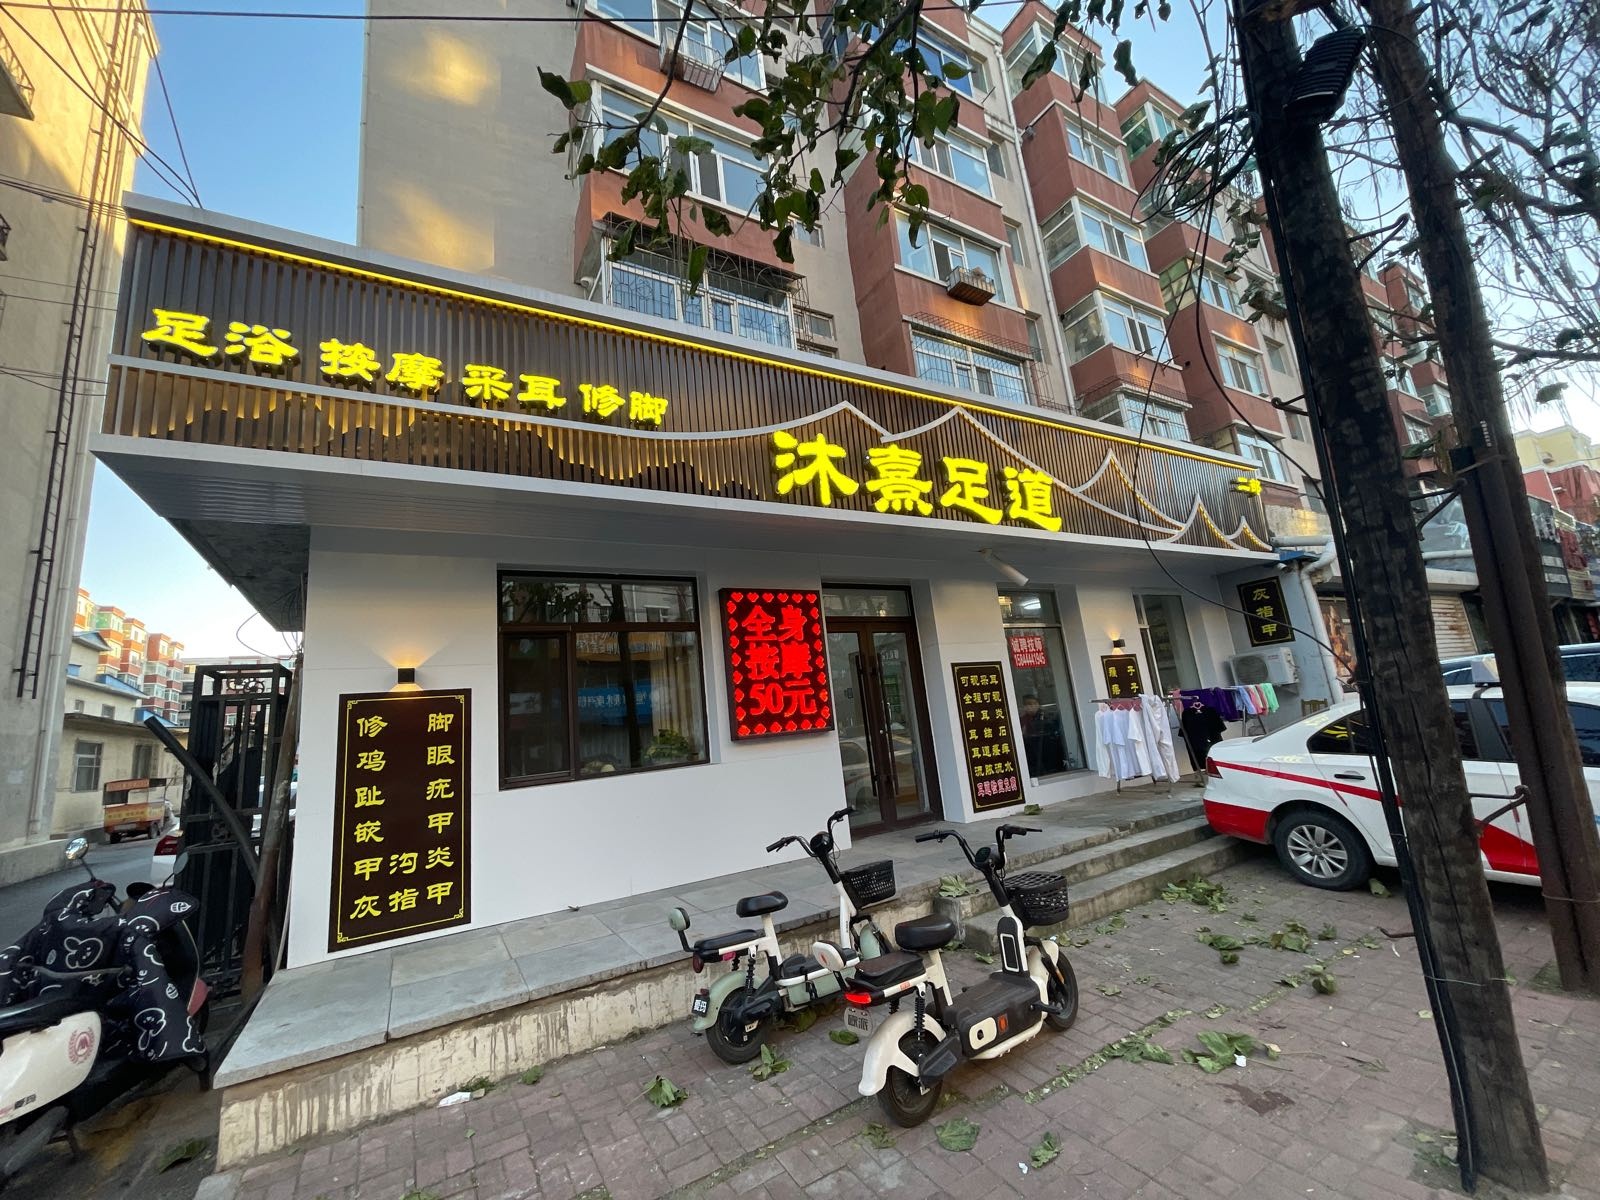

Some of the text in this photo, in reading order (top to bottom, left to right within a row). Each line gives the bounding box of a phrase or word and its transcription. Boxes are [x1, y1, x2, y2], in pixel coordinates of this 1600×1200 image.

[143, 308, 668, 426] 足浴 按摩 采耳 修脚
[773, 430, 1062, 533] 沐熹足道
[742, 604, 807, 641] 全身
[1252, 588, 1278, 637] 灰指甲
[745, 641, 813, 680] 按摩
[749, 678, 817, 717] 50元
[960, 674, 999, 687] 可视采耳
[963, 691, 1002, 705] 全程可视
[966, 708, 1005, 722] 中耳炎
[969, 726, 1007, 741] 耳结石
